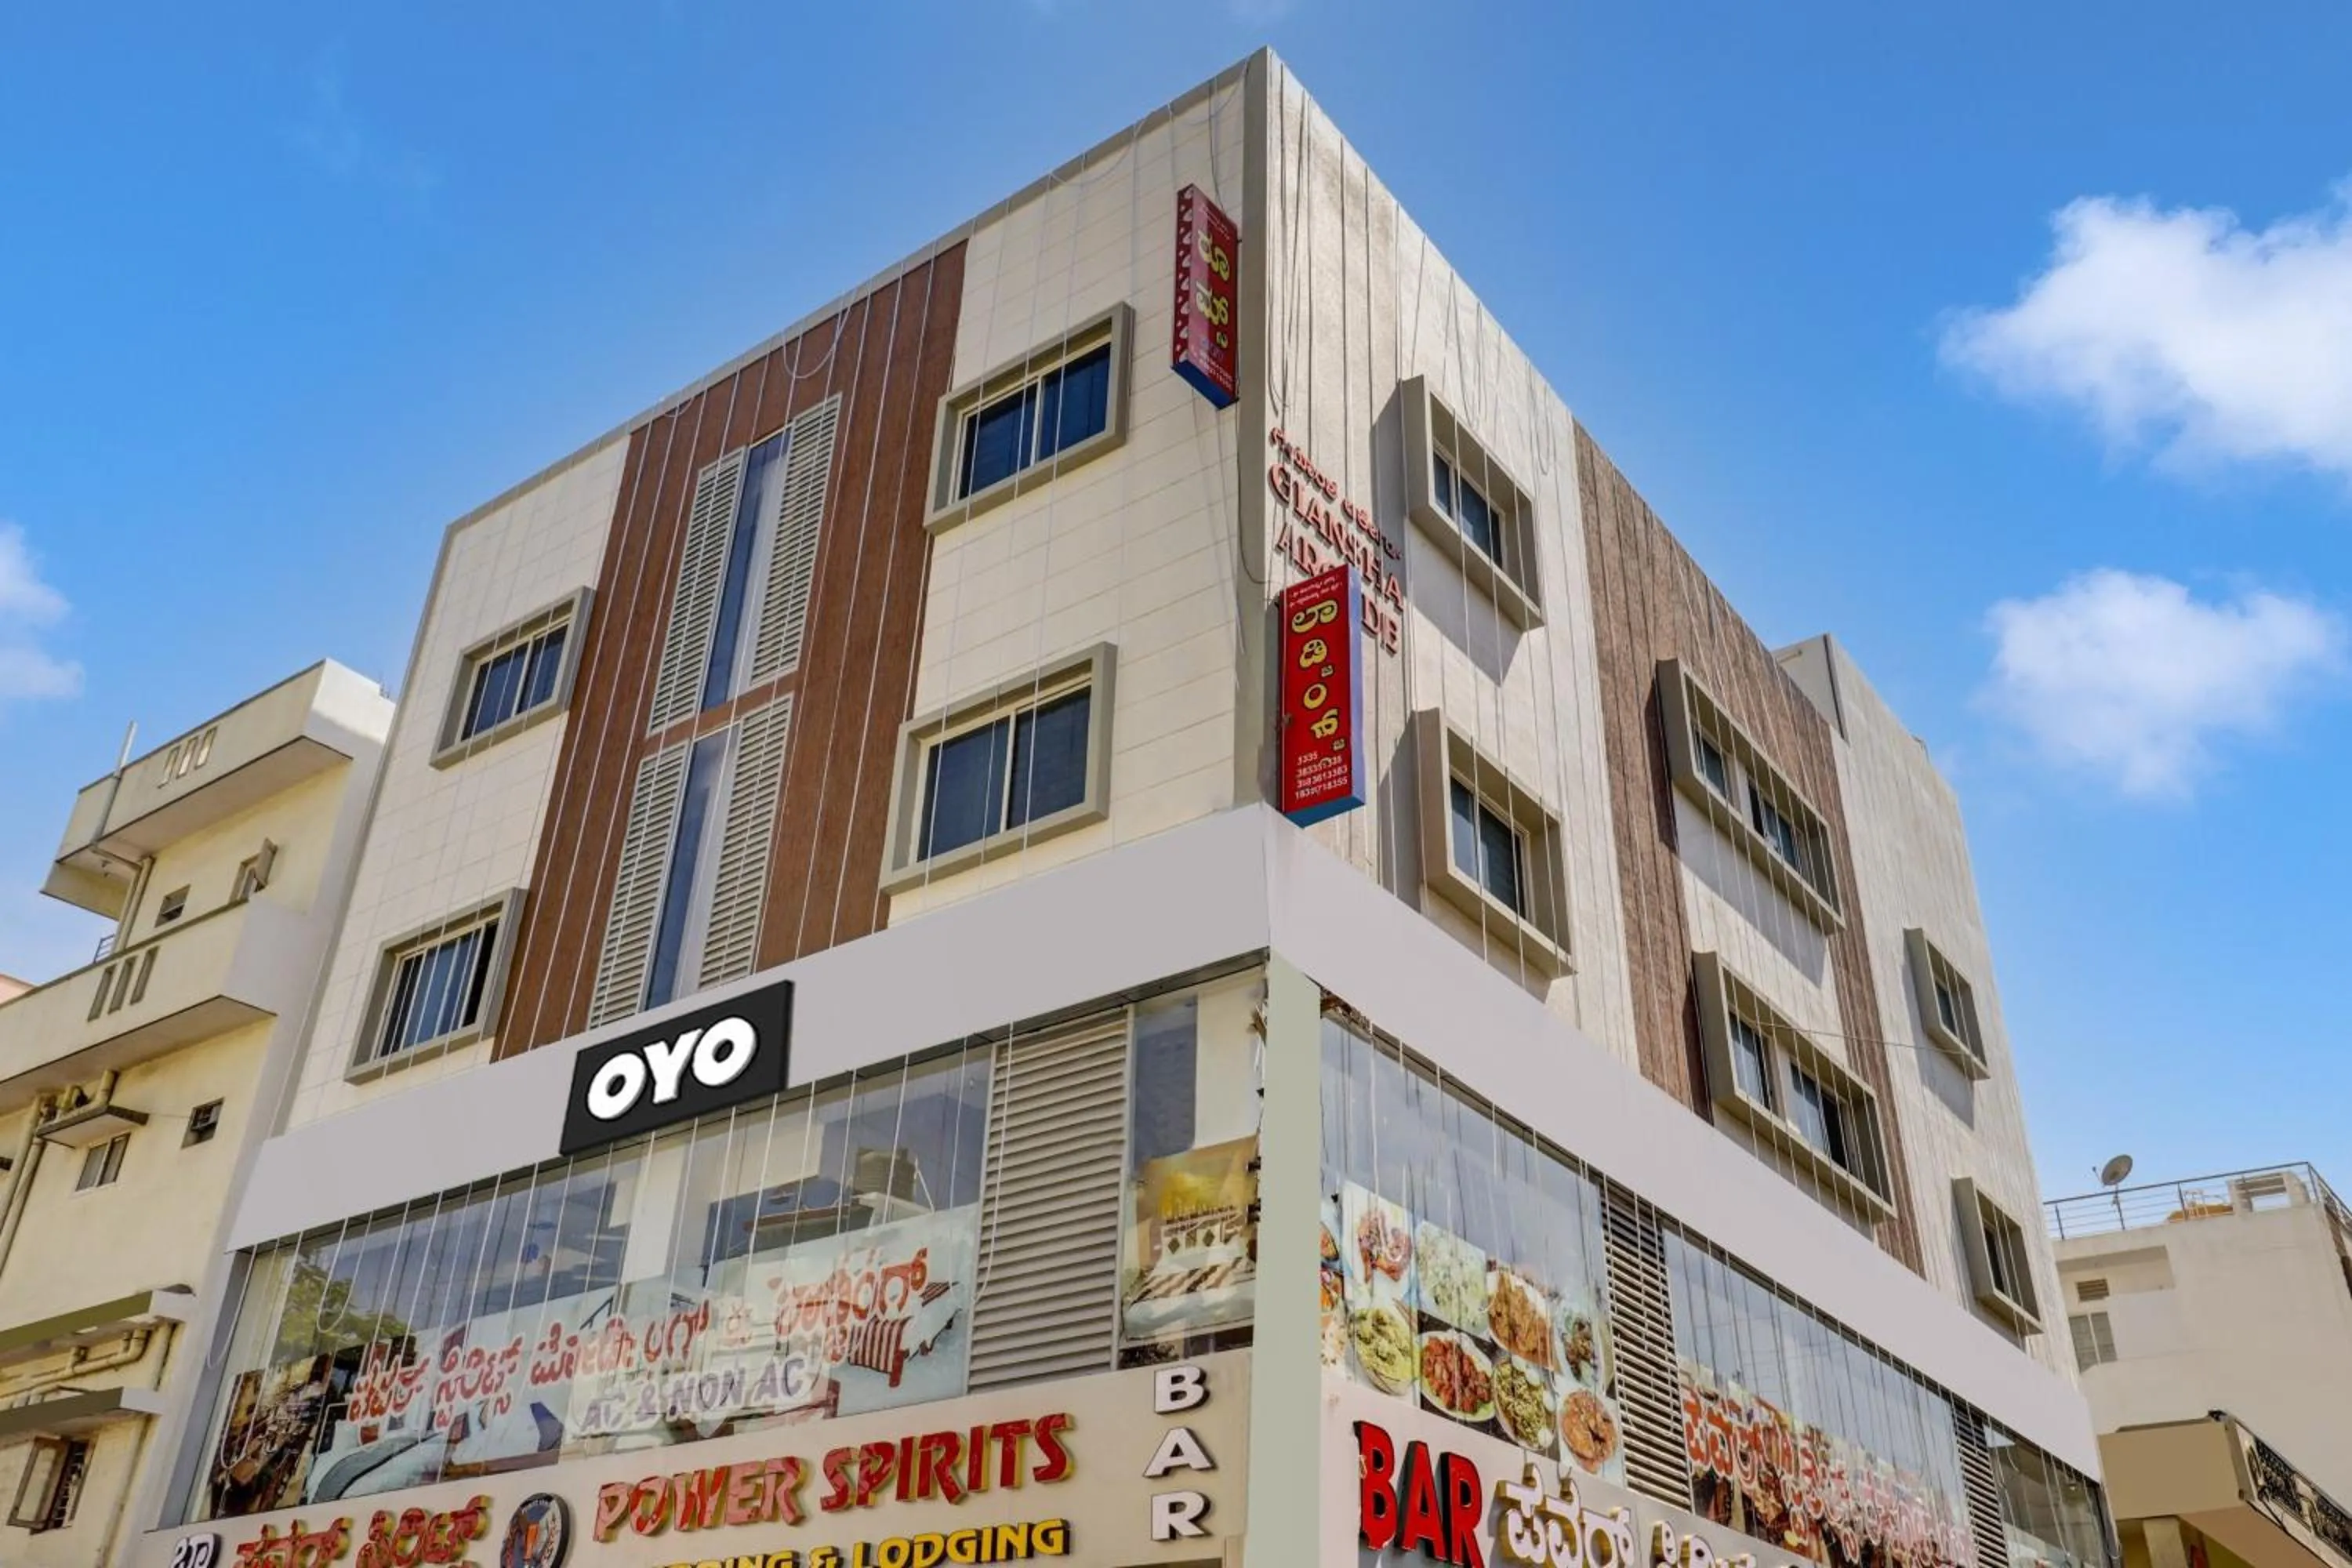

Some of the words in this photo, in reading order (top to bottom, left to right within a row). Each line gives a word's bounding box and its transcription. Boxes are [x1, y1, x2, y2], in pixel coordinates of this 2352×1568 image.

[1275, 523, 1398, 655] ARDE
[588, 1017, 757, 1120] OYO
[593, 1456, 806, 1542] POWER
[821, 1412, 1076, 1513] SPIRITS
[1143, 1365, 1217, 1541] BAR
[1354, 1420, 1484, 1568] BAR
[852, 1518, 1071, 1568] LODGING
